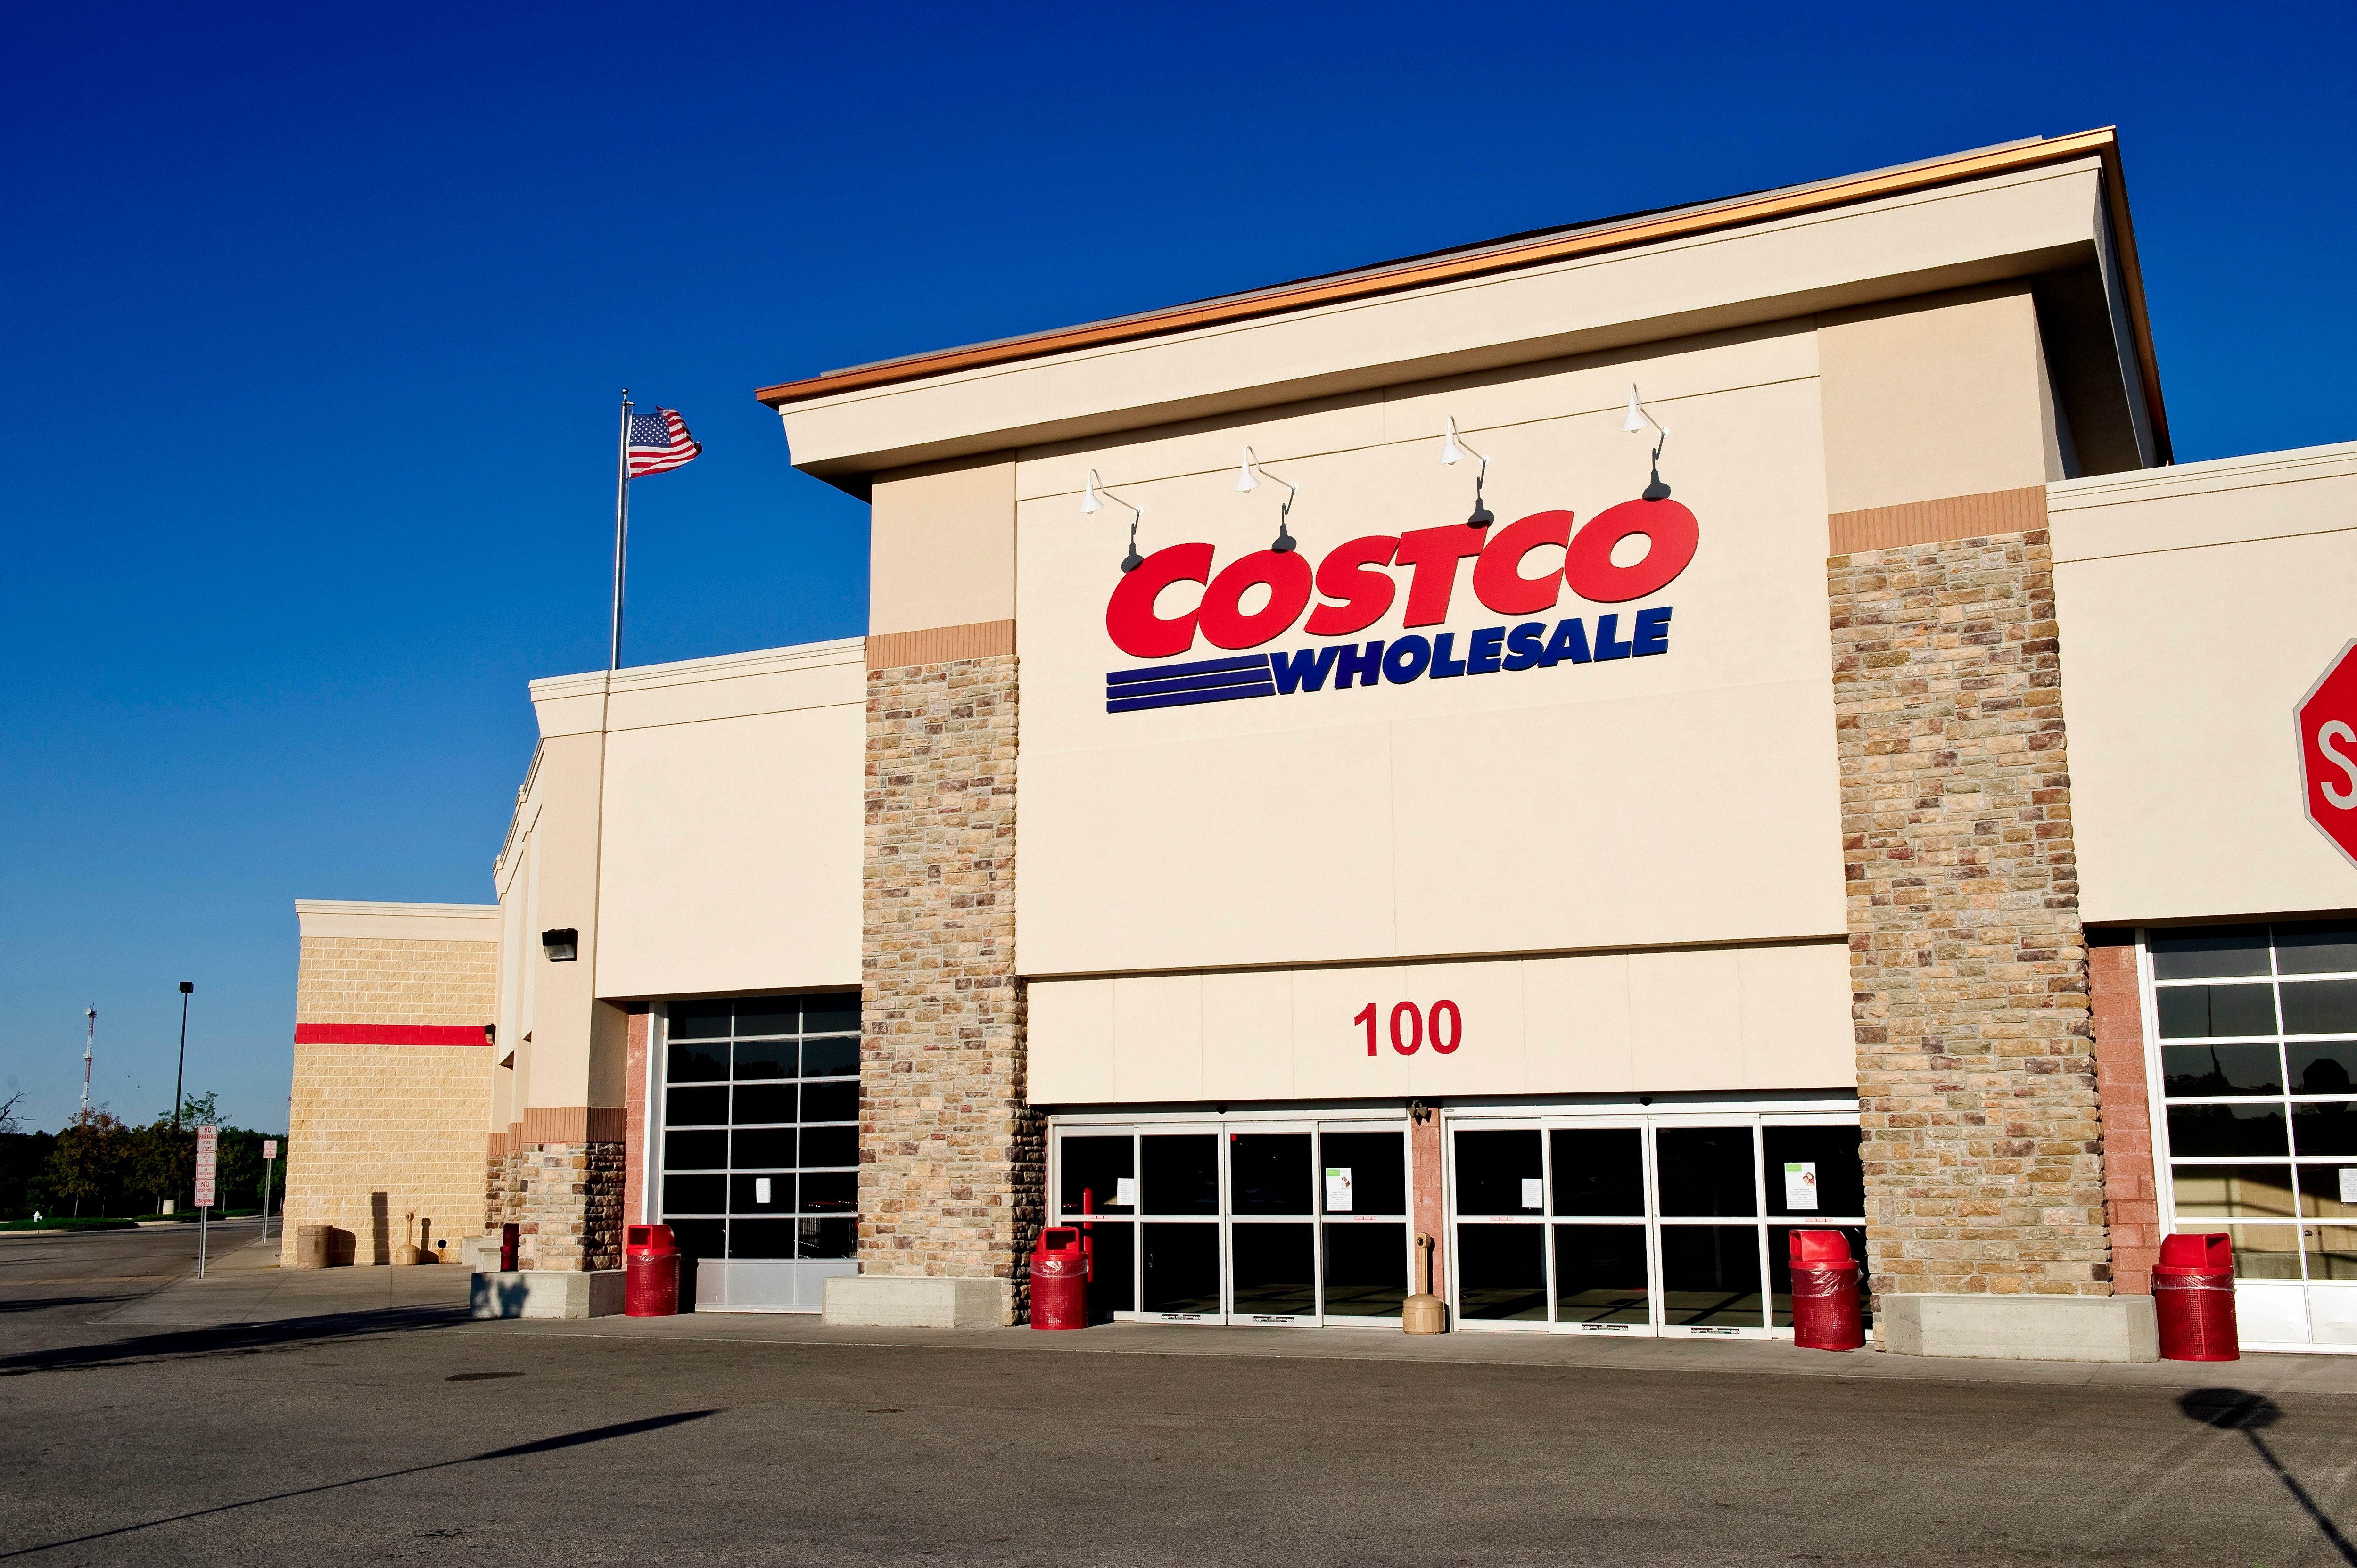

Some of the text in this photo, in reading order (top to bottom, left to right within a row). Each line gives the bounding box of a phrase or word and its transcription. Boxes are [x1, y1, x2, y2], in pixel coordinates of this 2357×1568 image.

[1106, 498, 1698, 657] COSTCO
[1268, 606, 1672, 694] WHOLESALE
[1354, 1000, 1461, 1056] 100
